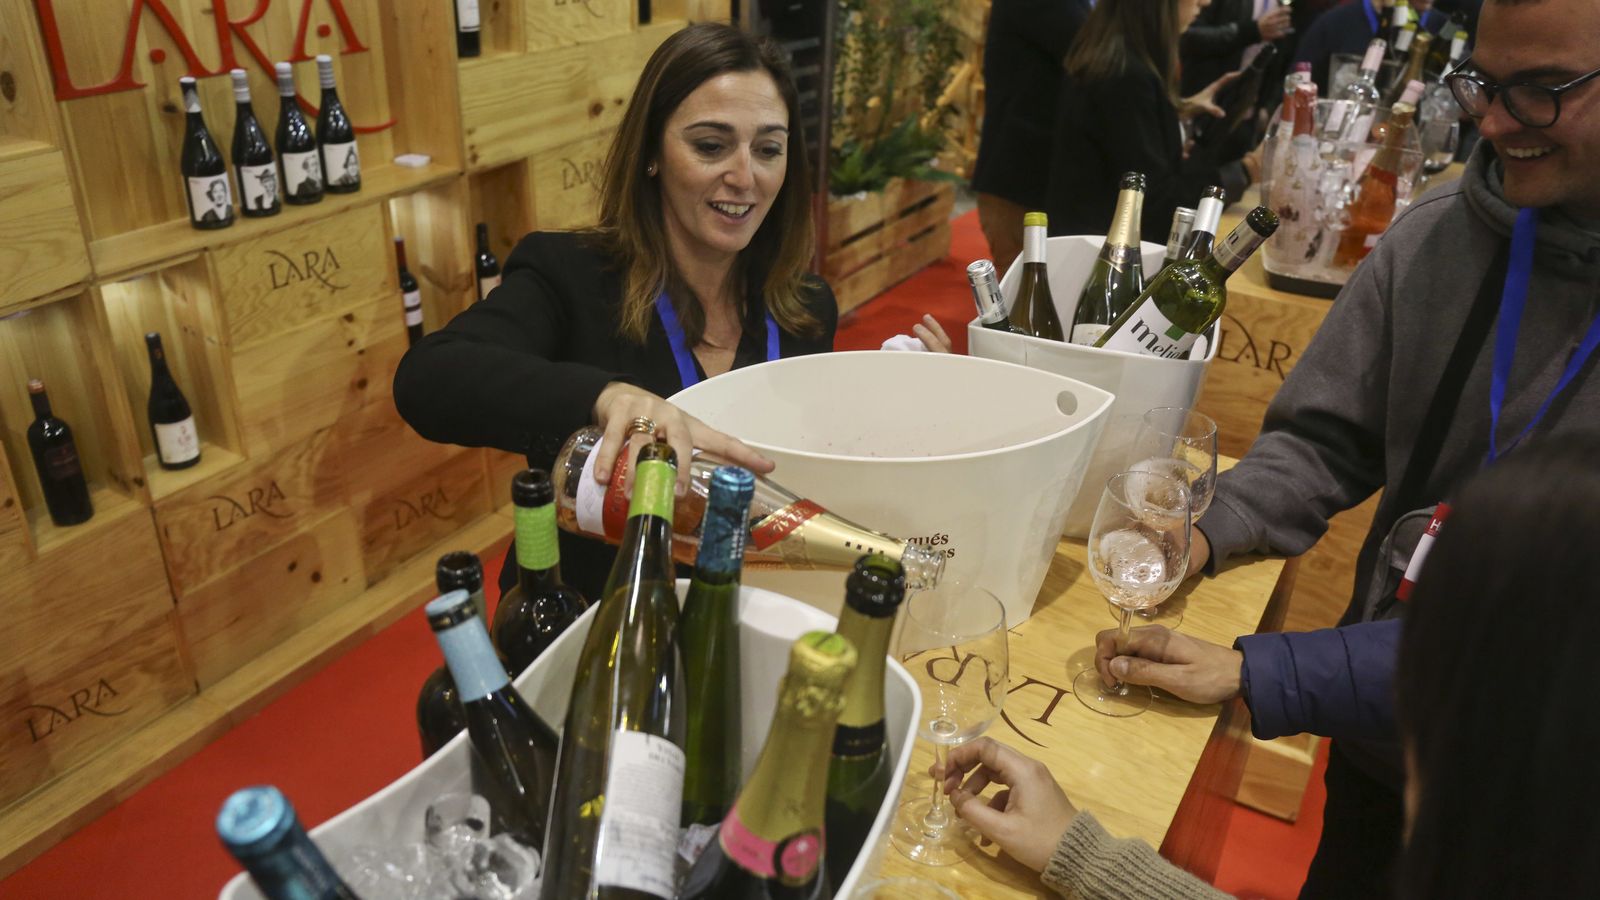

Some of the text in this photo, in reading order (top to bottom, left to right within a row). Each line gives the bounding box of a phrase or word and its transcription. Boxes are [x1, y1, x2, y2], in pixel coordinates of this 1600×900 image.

[561, 157, 603, 192] LAR
[263, 246, 352, 290] LARA
[1216, 312, 1293, 381] LAR
[208, 480, 296, 531] LARA
[394, 488, 457, 530] LARA
[13, 679, 134, 743] LARA
[902, 645, 1073, 749] LAR
